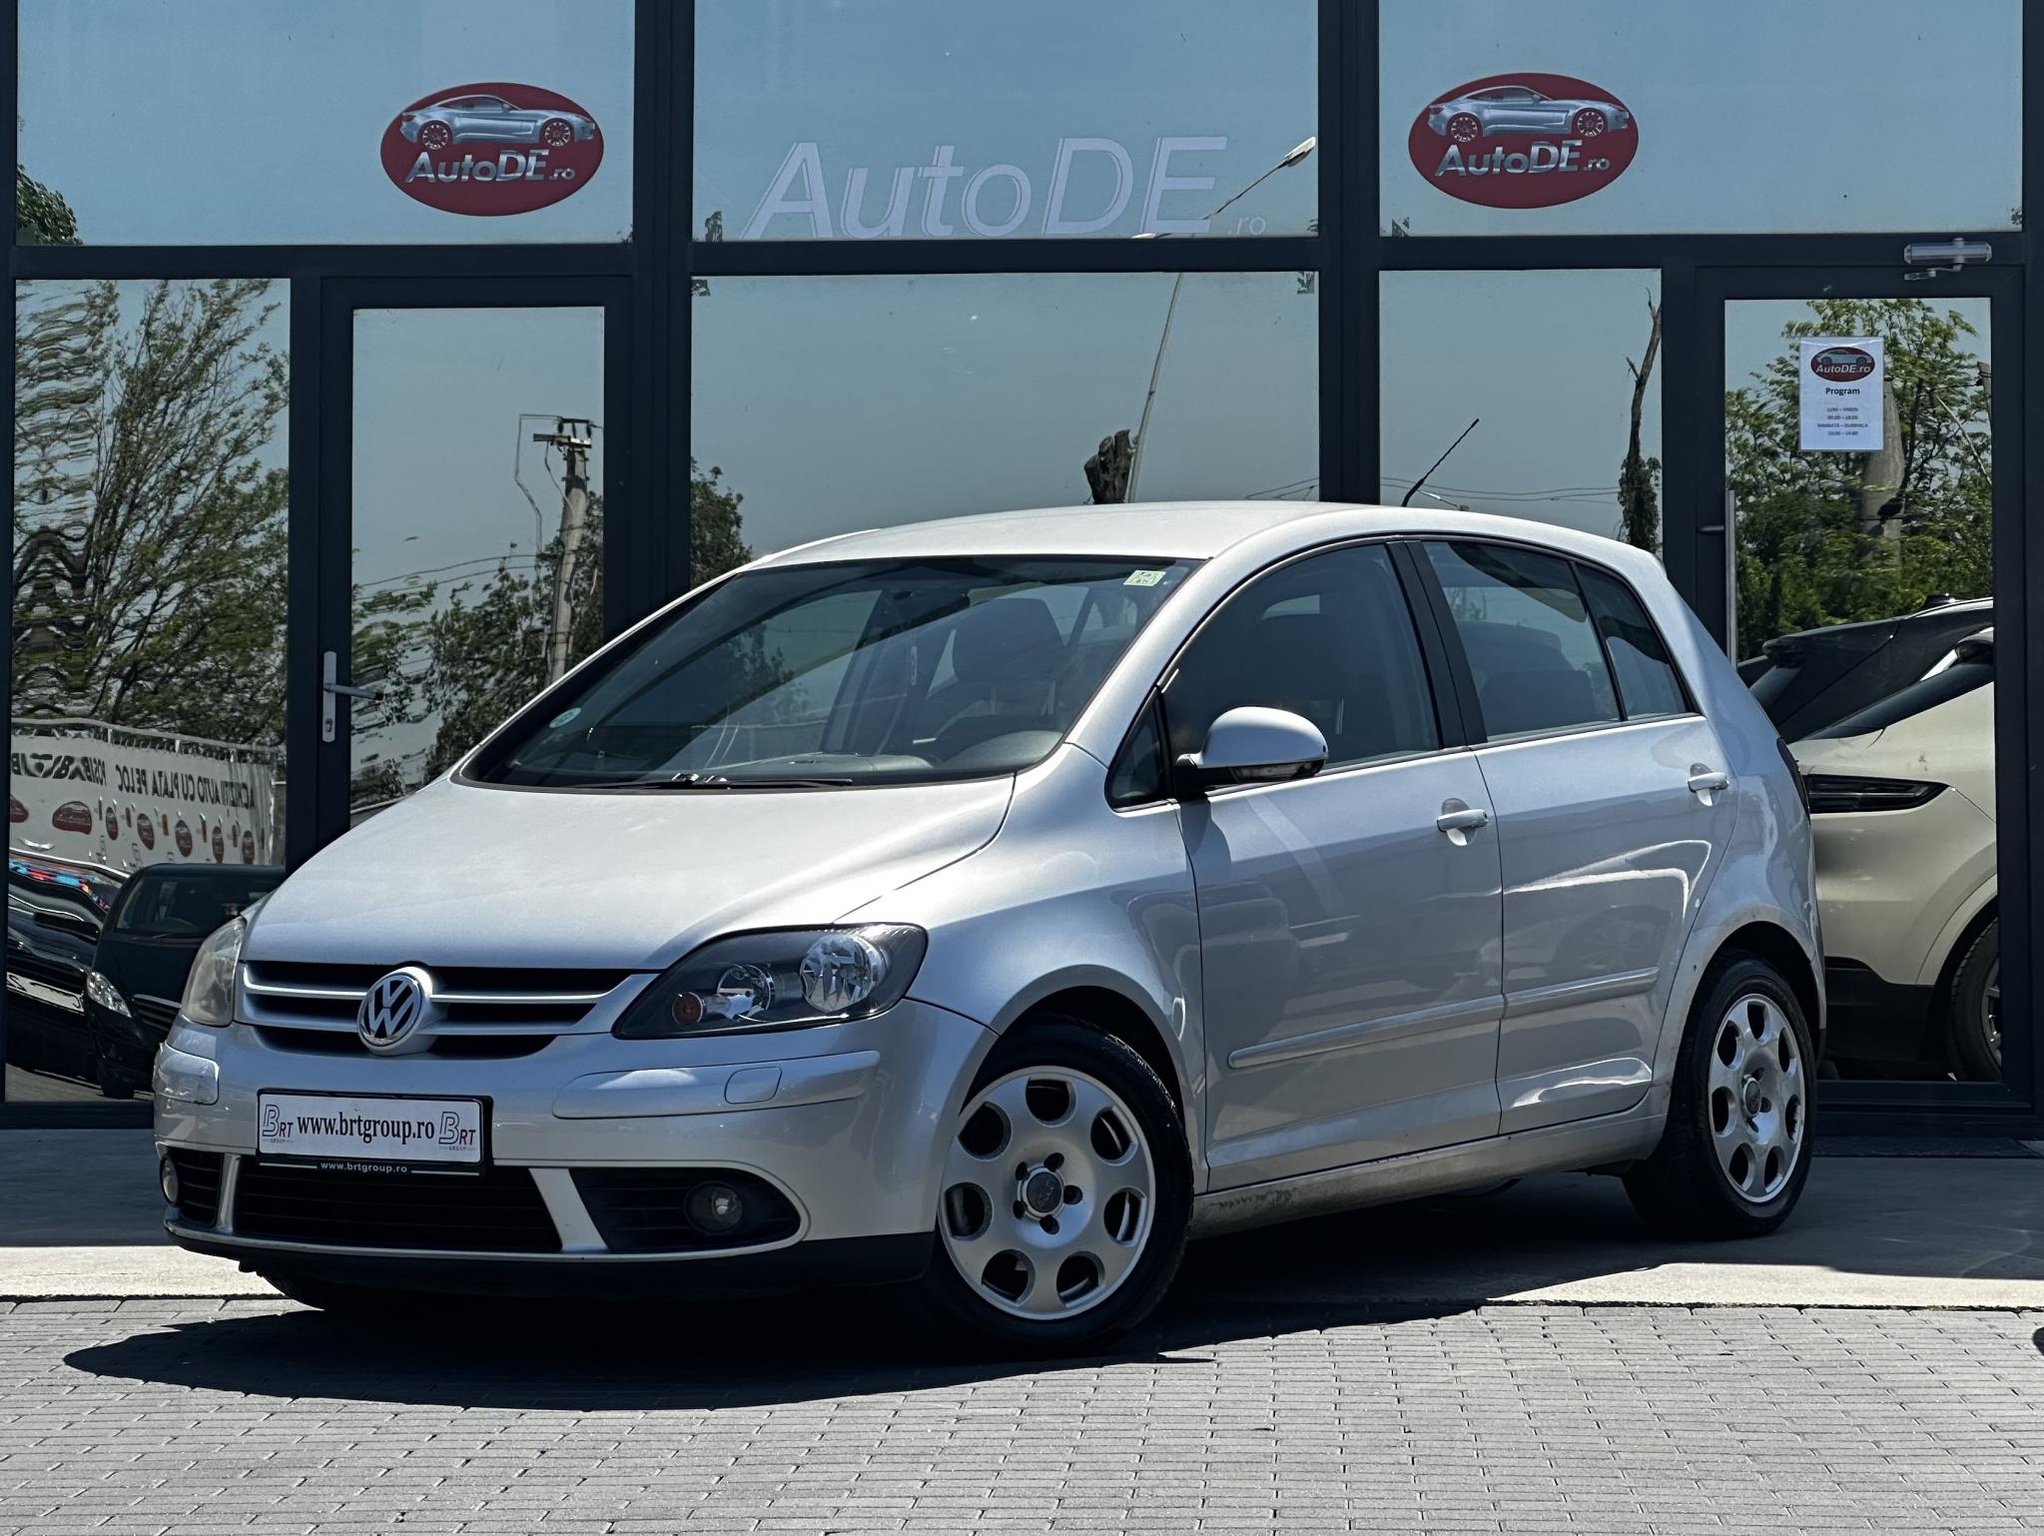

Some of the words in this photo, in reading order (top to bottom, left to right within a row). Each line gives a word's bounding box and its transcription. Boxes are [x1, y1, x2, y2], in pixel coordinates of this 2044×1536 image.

[1816, 363, 1871, 374] AutoDE.ro
[1825, 387, 1861, 396] Program
[262, 1104, 294, 1138] BRT
[297, 1111, 435, 1145] www.brtgroup.ro
[439, 1111, 476, 1146] BRT
[320, 1161, 408, 1174] www.brtgroup.ro
